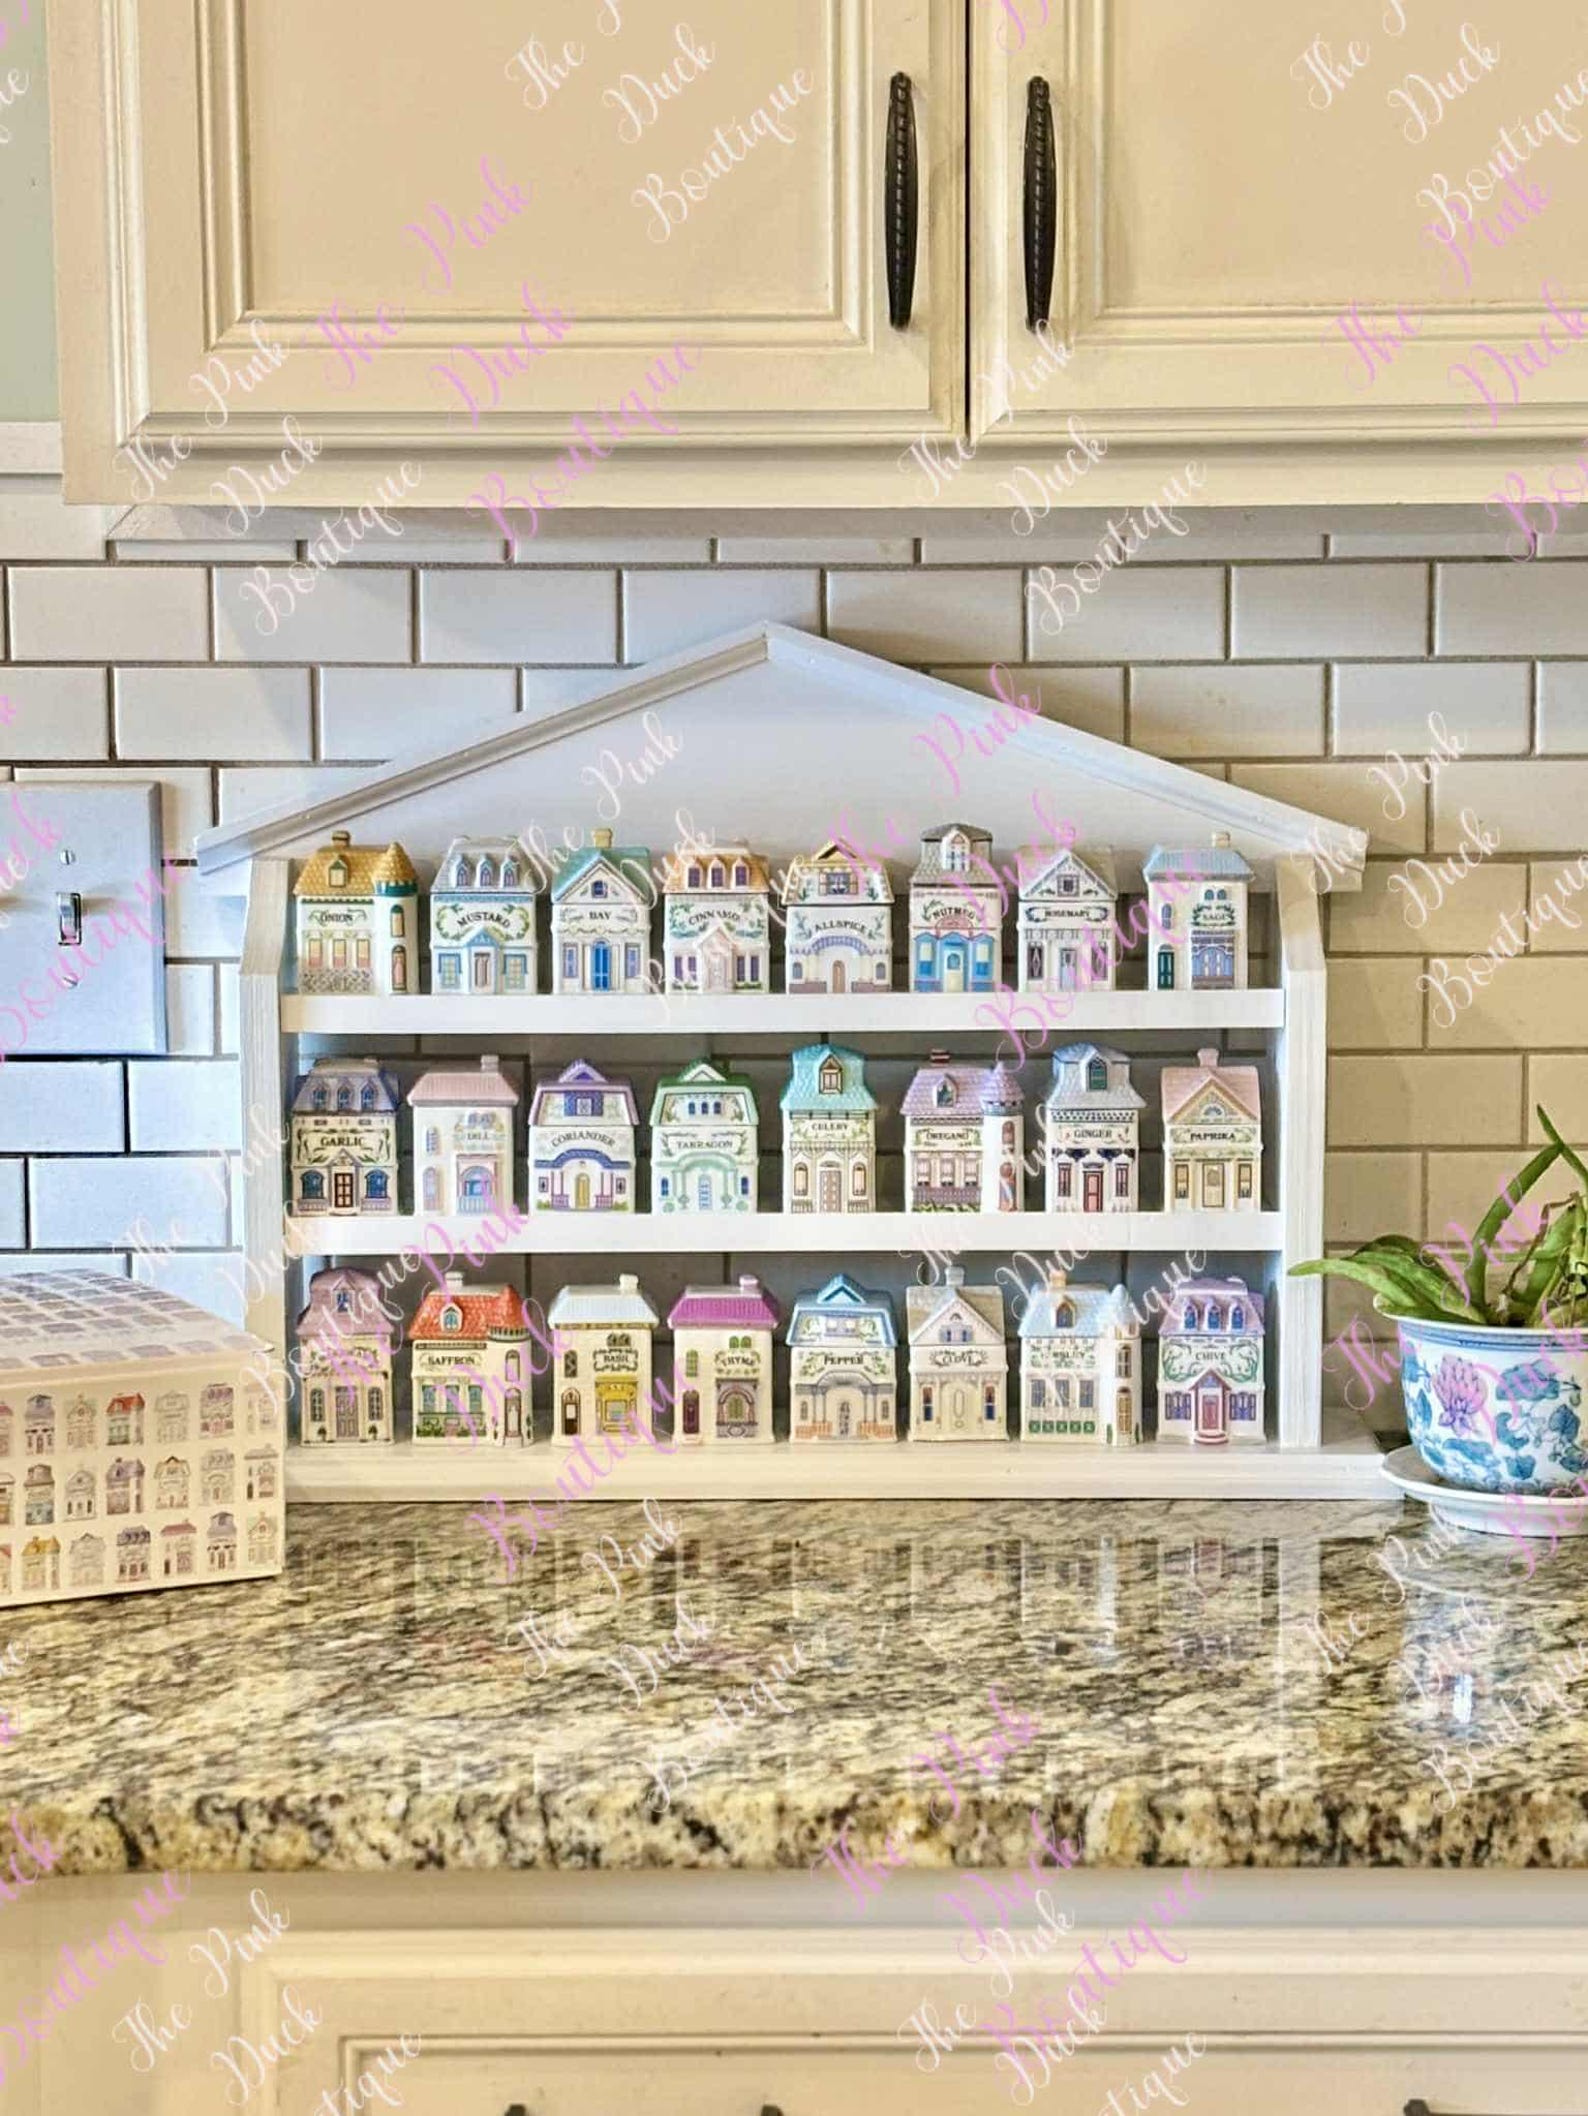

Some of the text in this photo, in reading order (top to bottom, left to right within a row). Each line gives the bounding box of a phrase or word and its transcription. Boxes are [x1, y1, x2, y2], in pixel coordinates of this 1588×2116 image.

[320, 911, 353, 924] ONION
[588, 911, 612, 920] BAY
[931, 906, 975, 920] NUTMEG
[1044, 909, 1090, 919] ROSEMARY
[1202, 913, 1227, 922] SAGE
[457, 911, 511, 929] MUSTARD
[813, 919, 868, 934] ALLSPICE
[811, 1122, 850, 1132] CELERY
[466, 1132, 491, 1142] DILL
[551, 1130, 616, 1148] CORIANDER
[925, 1129, 970, 1141] OREGANO
[1073, 1127, 1114, 1140] GINGER
[1189, 1131, 1237, 1142] PAPRIKA
[319, 1136, 366, 1148] GARLIC
[676, 1140, 734, 1150] TARRAGON
[427, 1355, 477, 1367] SAFFRON
[603, 1354, 630, 1364] BASIL
[719, 1354, 756, 1368] THYME
[823, 1353, 865, 1366] PEPPER
[941, 1352, 976, 1366] CLOVE
[1194, 1350, 1227, 1362] CHIVE
